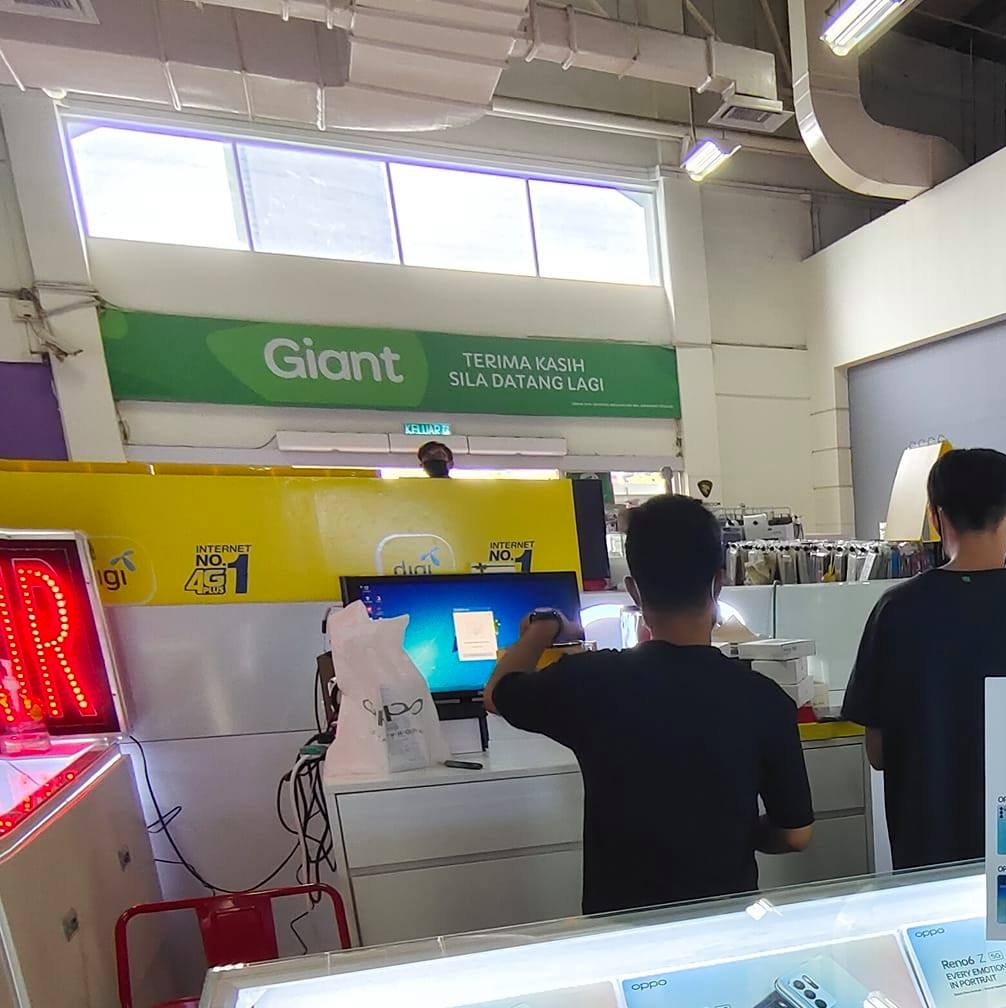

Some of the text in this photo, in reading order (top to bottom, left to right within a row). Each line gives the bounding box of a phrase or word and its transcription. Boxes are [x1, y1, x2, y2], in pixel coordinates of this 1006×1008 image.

[264, 337, 404, 383] Giant
[463, 352, 585, 373] TERIMA KASIH
[449, 371, 604, 392] SILA DATANG LAGI
[196, 544, 252, 553] INTERNET
[489, 541, 535, 549] INTERNET
[489, 550, 514, 562] NO.
[100, 568, 127, 591] igi
[184, 567, 227, 595] 4G
[196, 554, 249, 594] NO. 1
[915, 927, 944, 938] oppo
[941, 956, 975, 970] Reno6
[977, 954, 986, 963] Z
[945, 970, 973, 981] EVERY
[950, 981, 959, 990] IN
[959, 975, 998, 988] PORTRAIT
[631, 979, 667, 991] oppo
